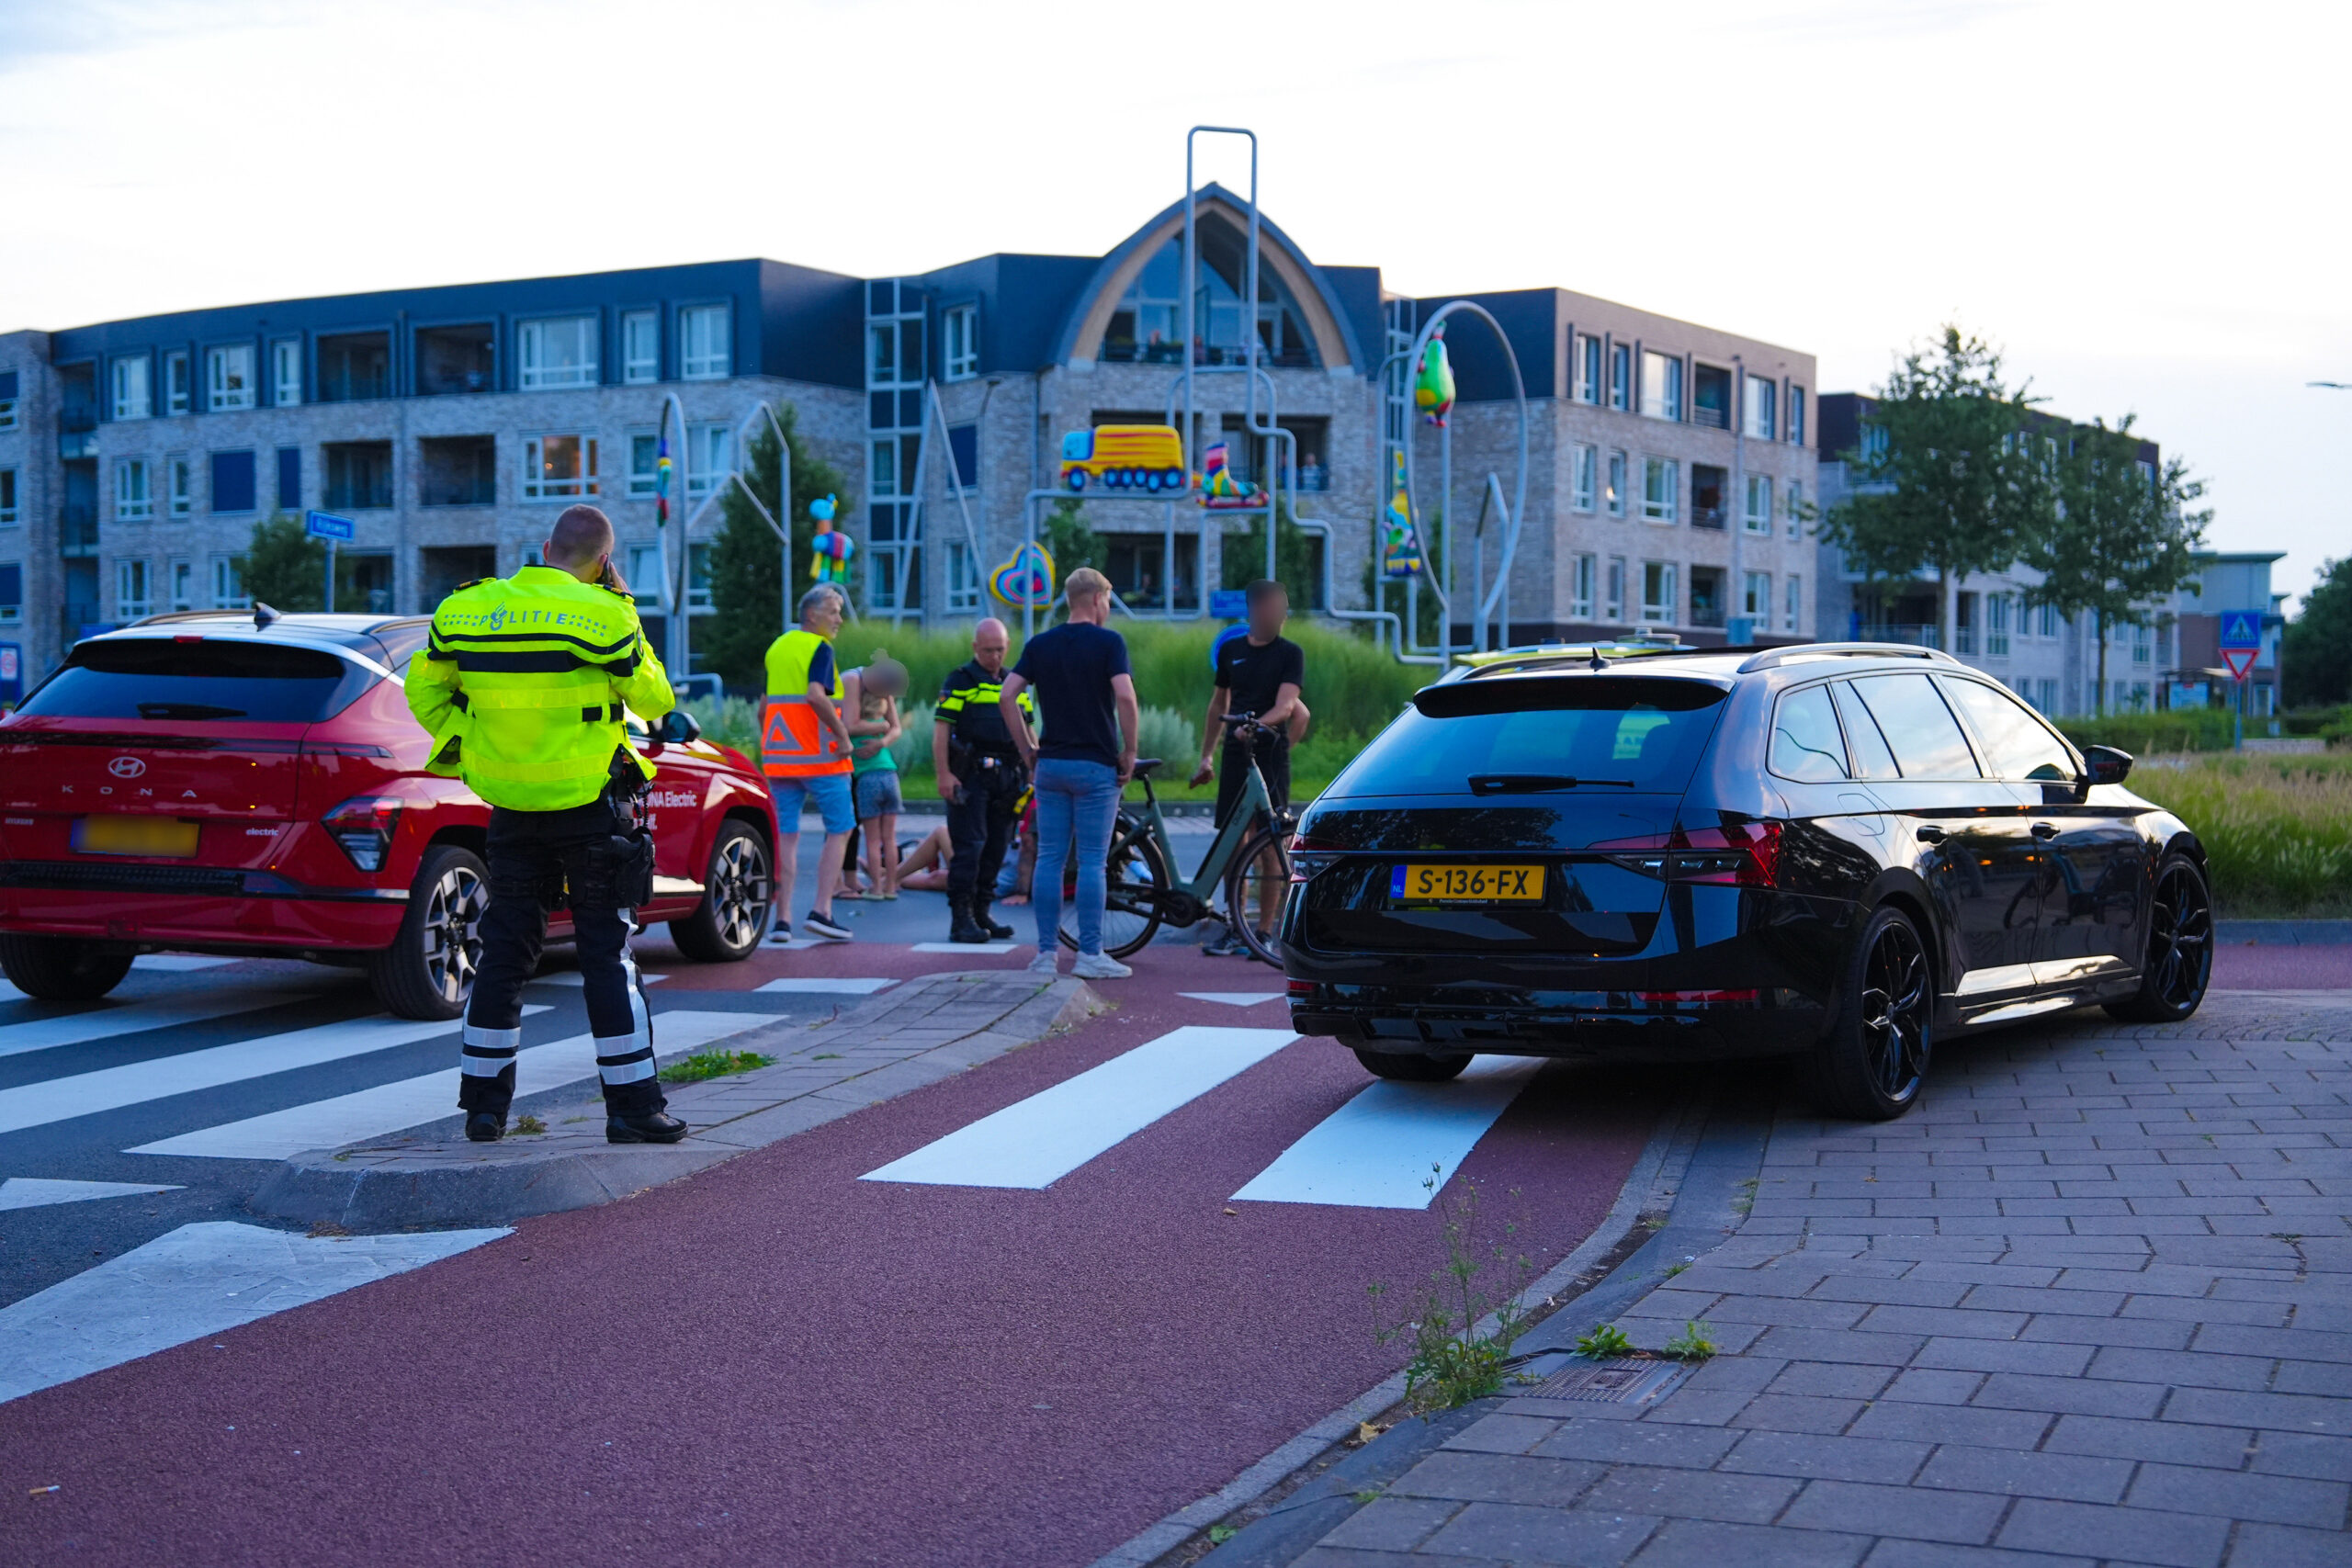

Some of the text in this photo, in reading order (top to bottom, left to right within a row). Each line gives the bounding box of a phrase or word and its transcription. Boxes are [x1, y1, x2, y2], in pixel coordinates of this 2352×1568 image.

[62, 784, 198, 798] KONA
[665, 790, 696, 807] Electric
[245, 828, 279, 836] electric
[1393, 885, 1403, 893] NL
[1418, 869, 1529, 895] S-136-FX
